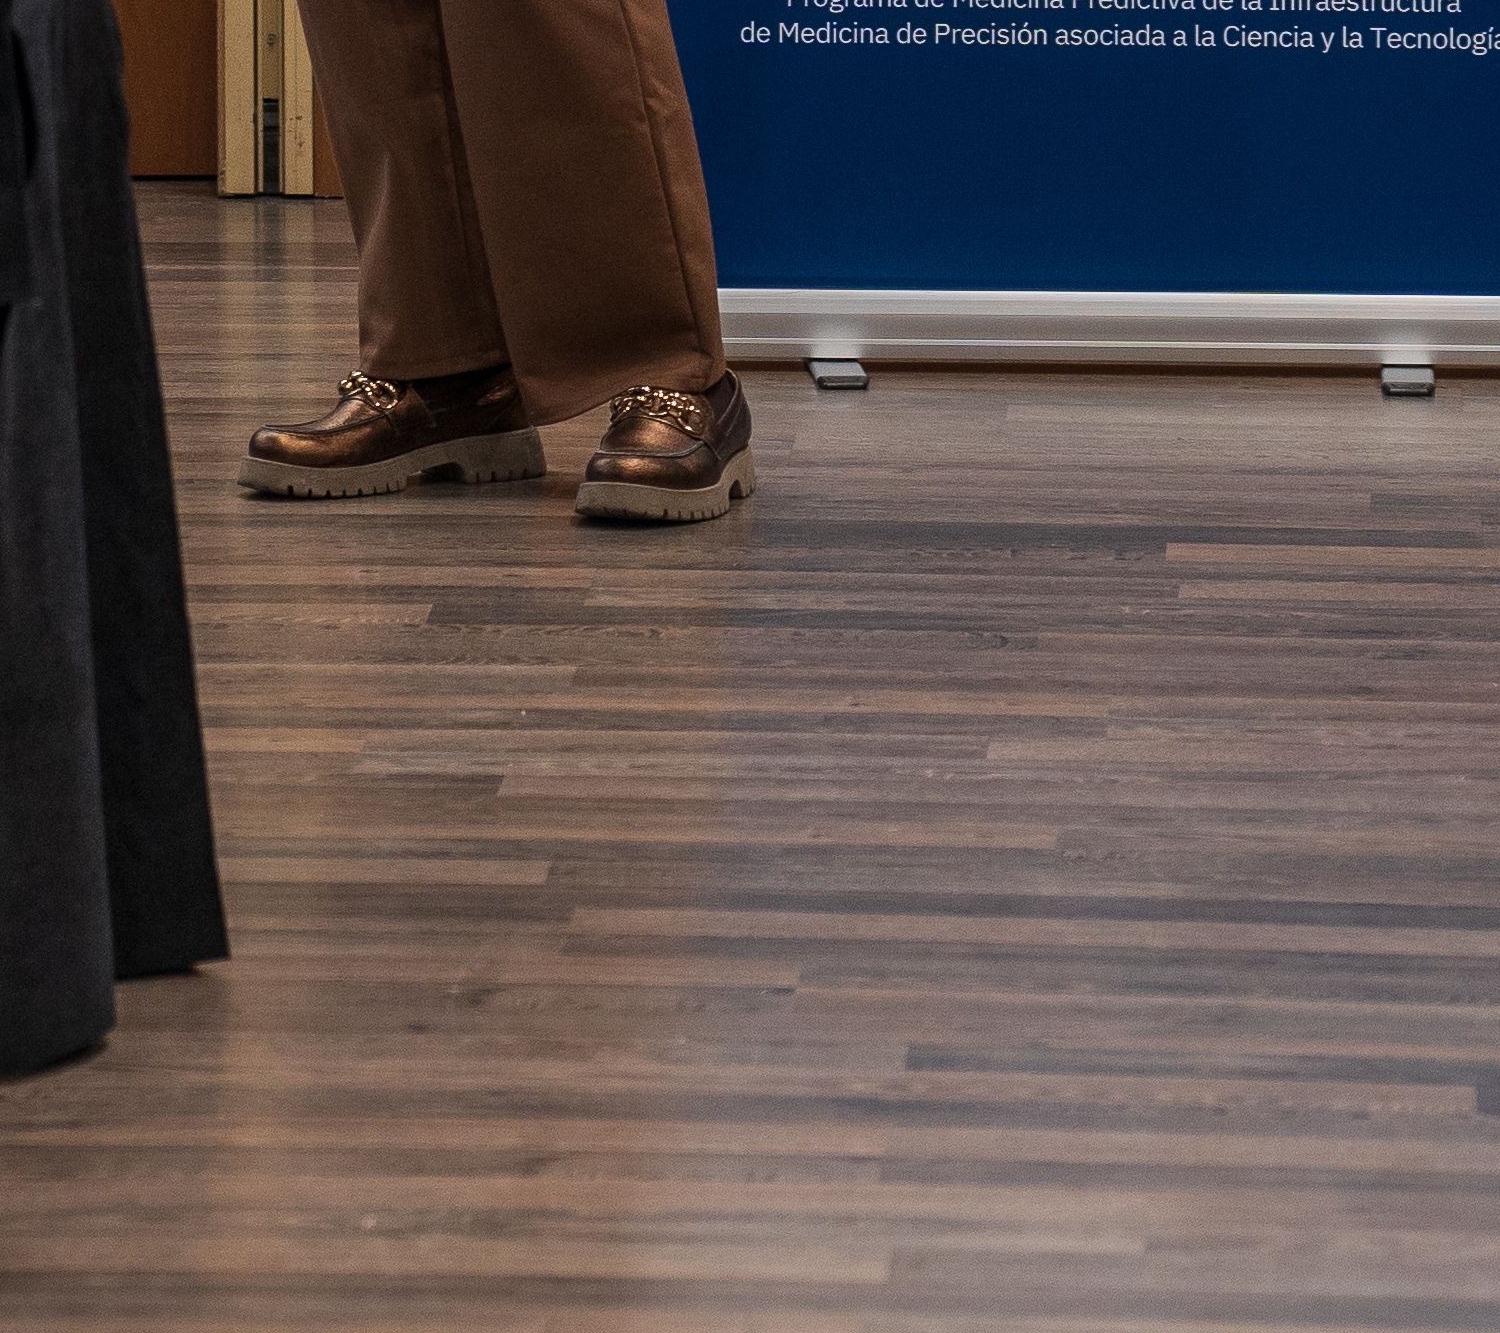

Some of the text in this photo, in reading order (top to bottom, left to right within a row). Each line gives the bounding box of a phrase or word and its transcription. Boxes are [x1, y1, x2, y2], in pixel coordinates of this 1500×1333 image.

[740, 21, 770, 43] de
[779, 21, 889, 44] Medicina
[896, 22, 927, 44] de
[934, 22, 1048, 45] Precisión
[1055, 23, 1166, 46] asociada
[1173, 30, 1187, 47] a
[1195, 24, 1215, 47] la
[1223, 25, 1314, 48] Ciencia
[1322, 31, 1335, 53] y
[1342, 26, 1364, 49] la
